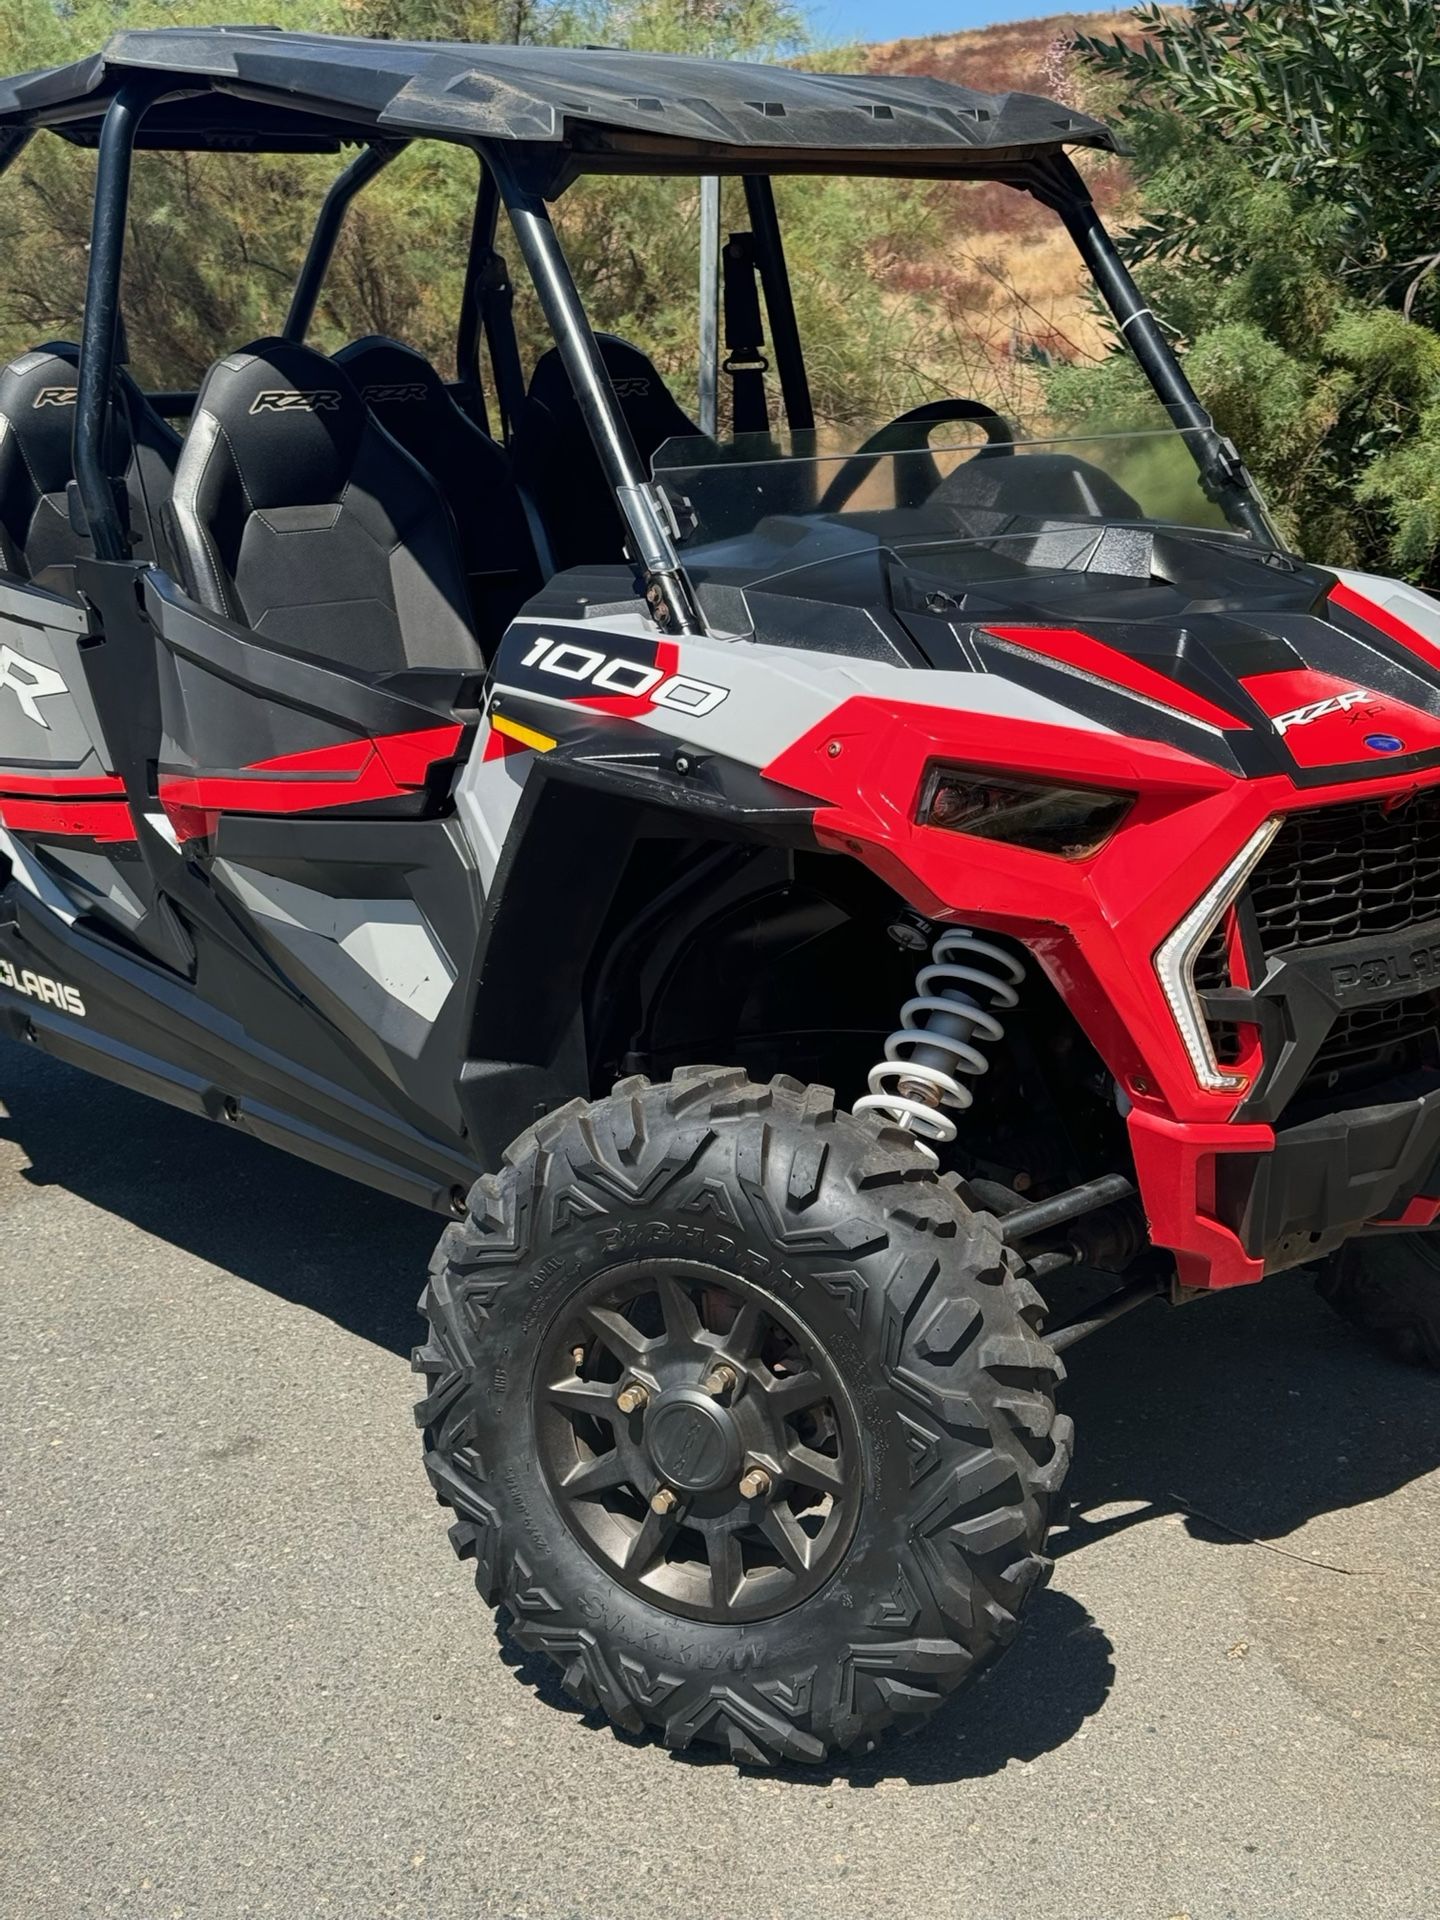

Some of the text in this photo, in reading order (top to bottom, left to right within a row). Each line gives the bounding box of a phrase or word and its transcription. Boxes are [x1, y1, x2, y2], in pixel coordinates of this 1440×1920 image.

[33, 386, 78, 409] RZ
[360, 383, 428, 402] RZR
[610, 377, 650, 398] ZR
[249, 390, 342, 415] RZR
[520, 636, 731, 718] 1000
[1271, 689, 1377, 736] RZR
